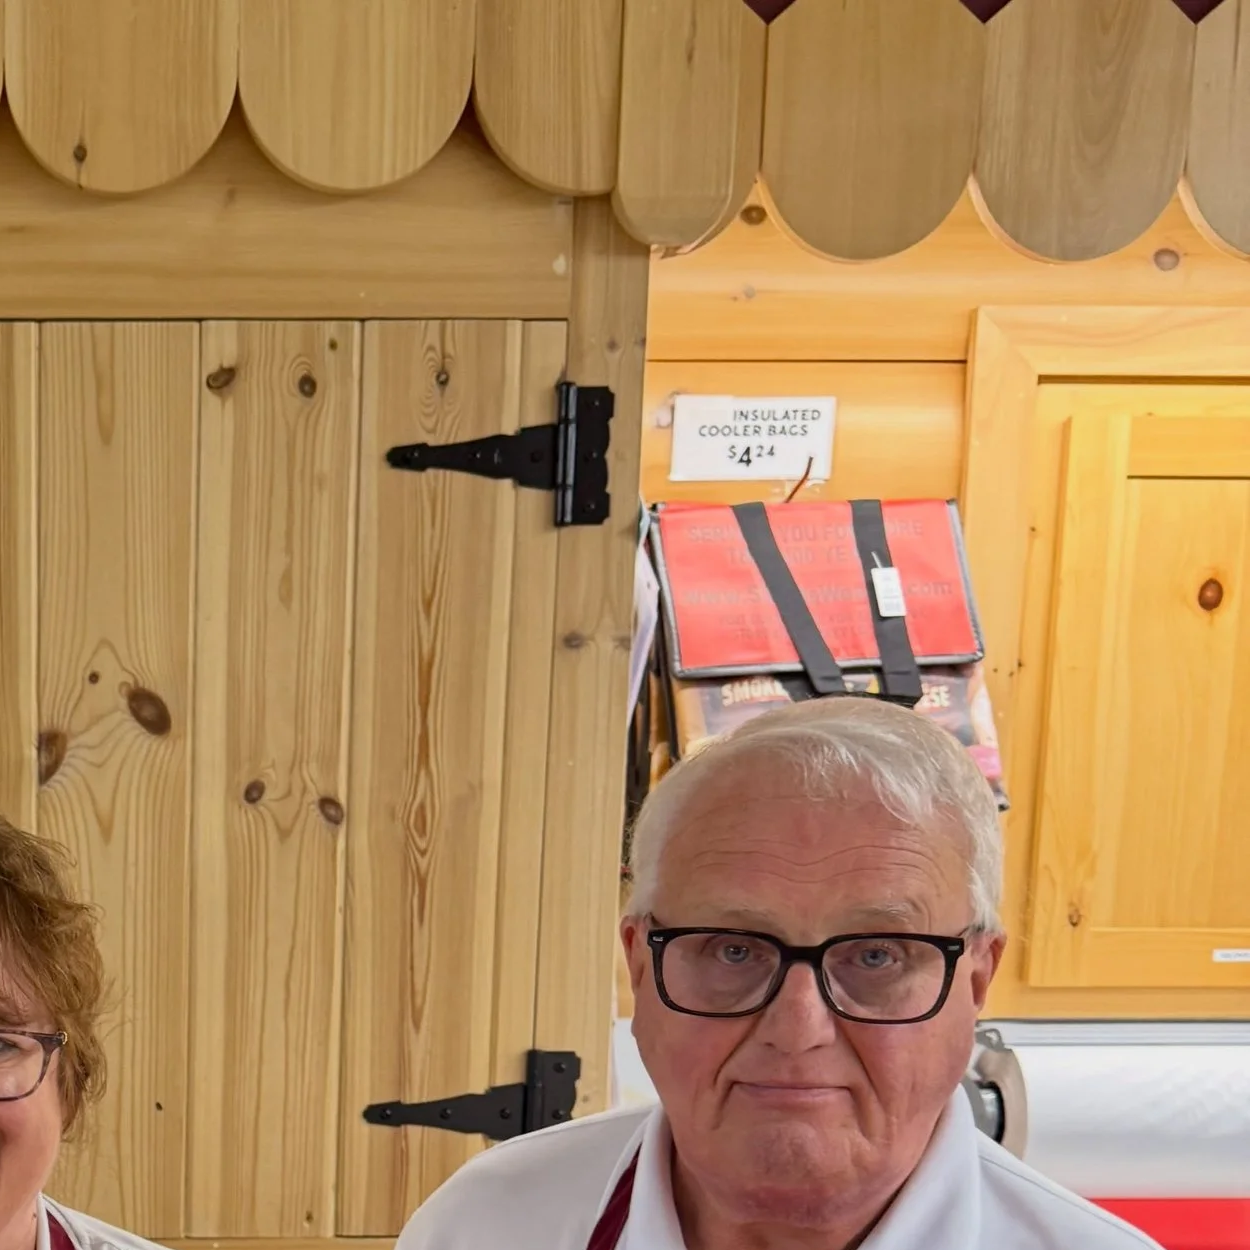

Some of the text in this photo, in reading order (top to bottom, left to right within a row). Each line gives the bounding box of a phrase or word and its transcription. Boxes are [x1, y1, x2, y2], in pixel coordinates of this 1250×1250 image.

[733, 409, 822, 421] INSULATED
[698, 425, 809, 437] COOLER BAGS
